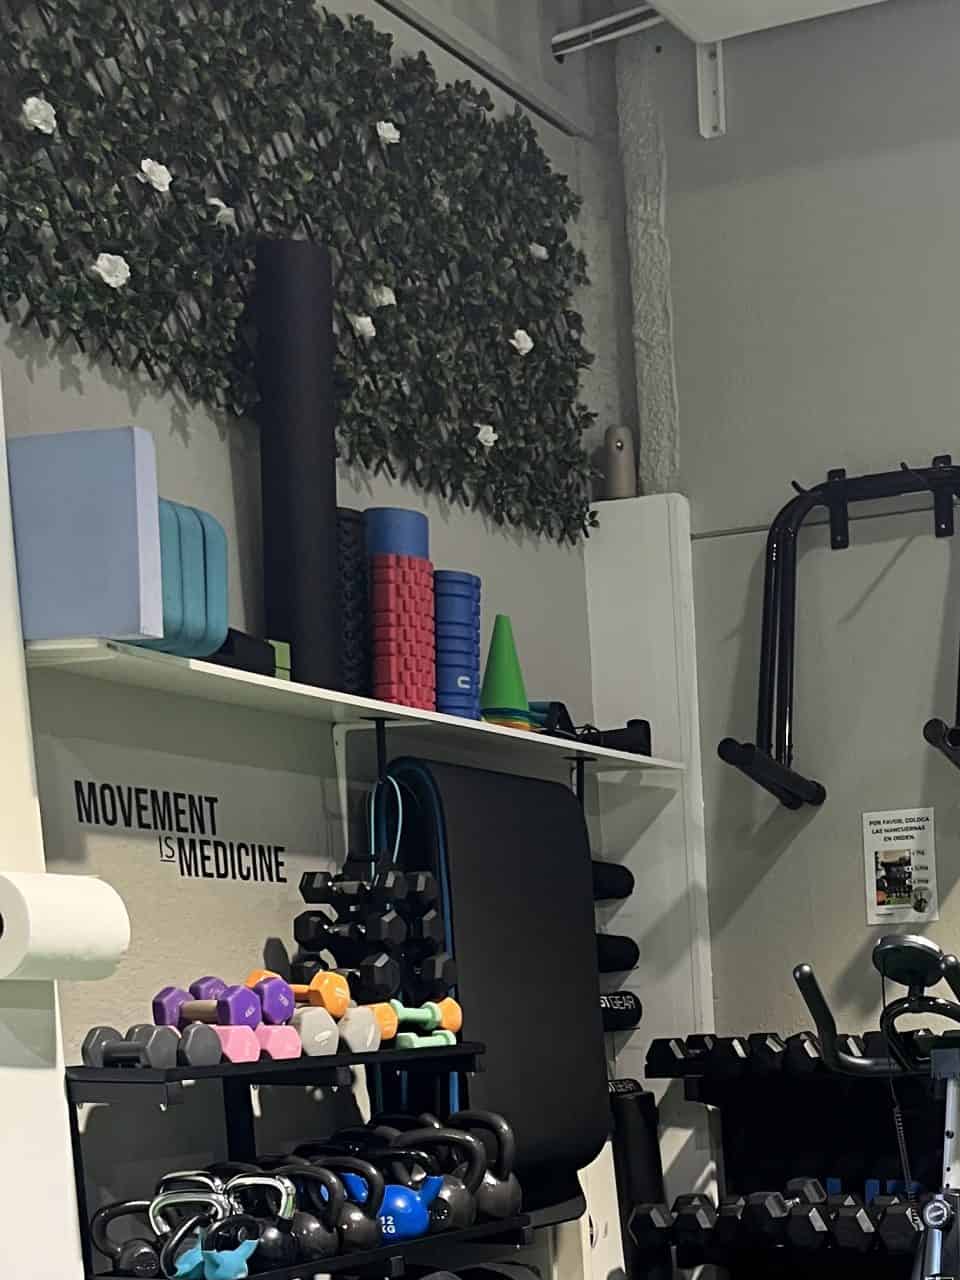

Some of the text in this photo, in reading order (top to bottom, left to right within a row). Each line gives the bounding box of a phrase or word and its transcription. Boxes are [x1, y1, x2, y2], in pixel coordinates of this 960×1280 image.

[74, 780, 218, 836] MOVEMENT
[159, 835, 288, 883] IS MEDICINE
[380, 1215, 394, 1225] 12
